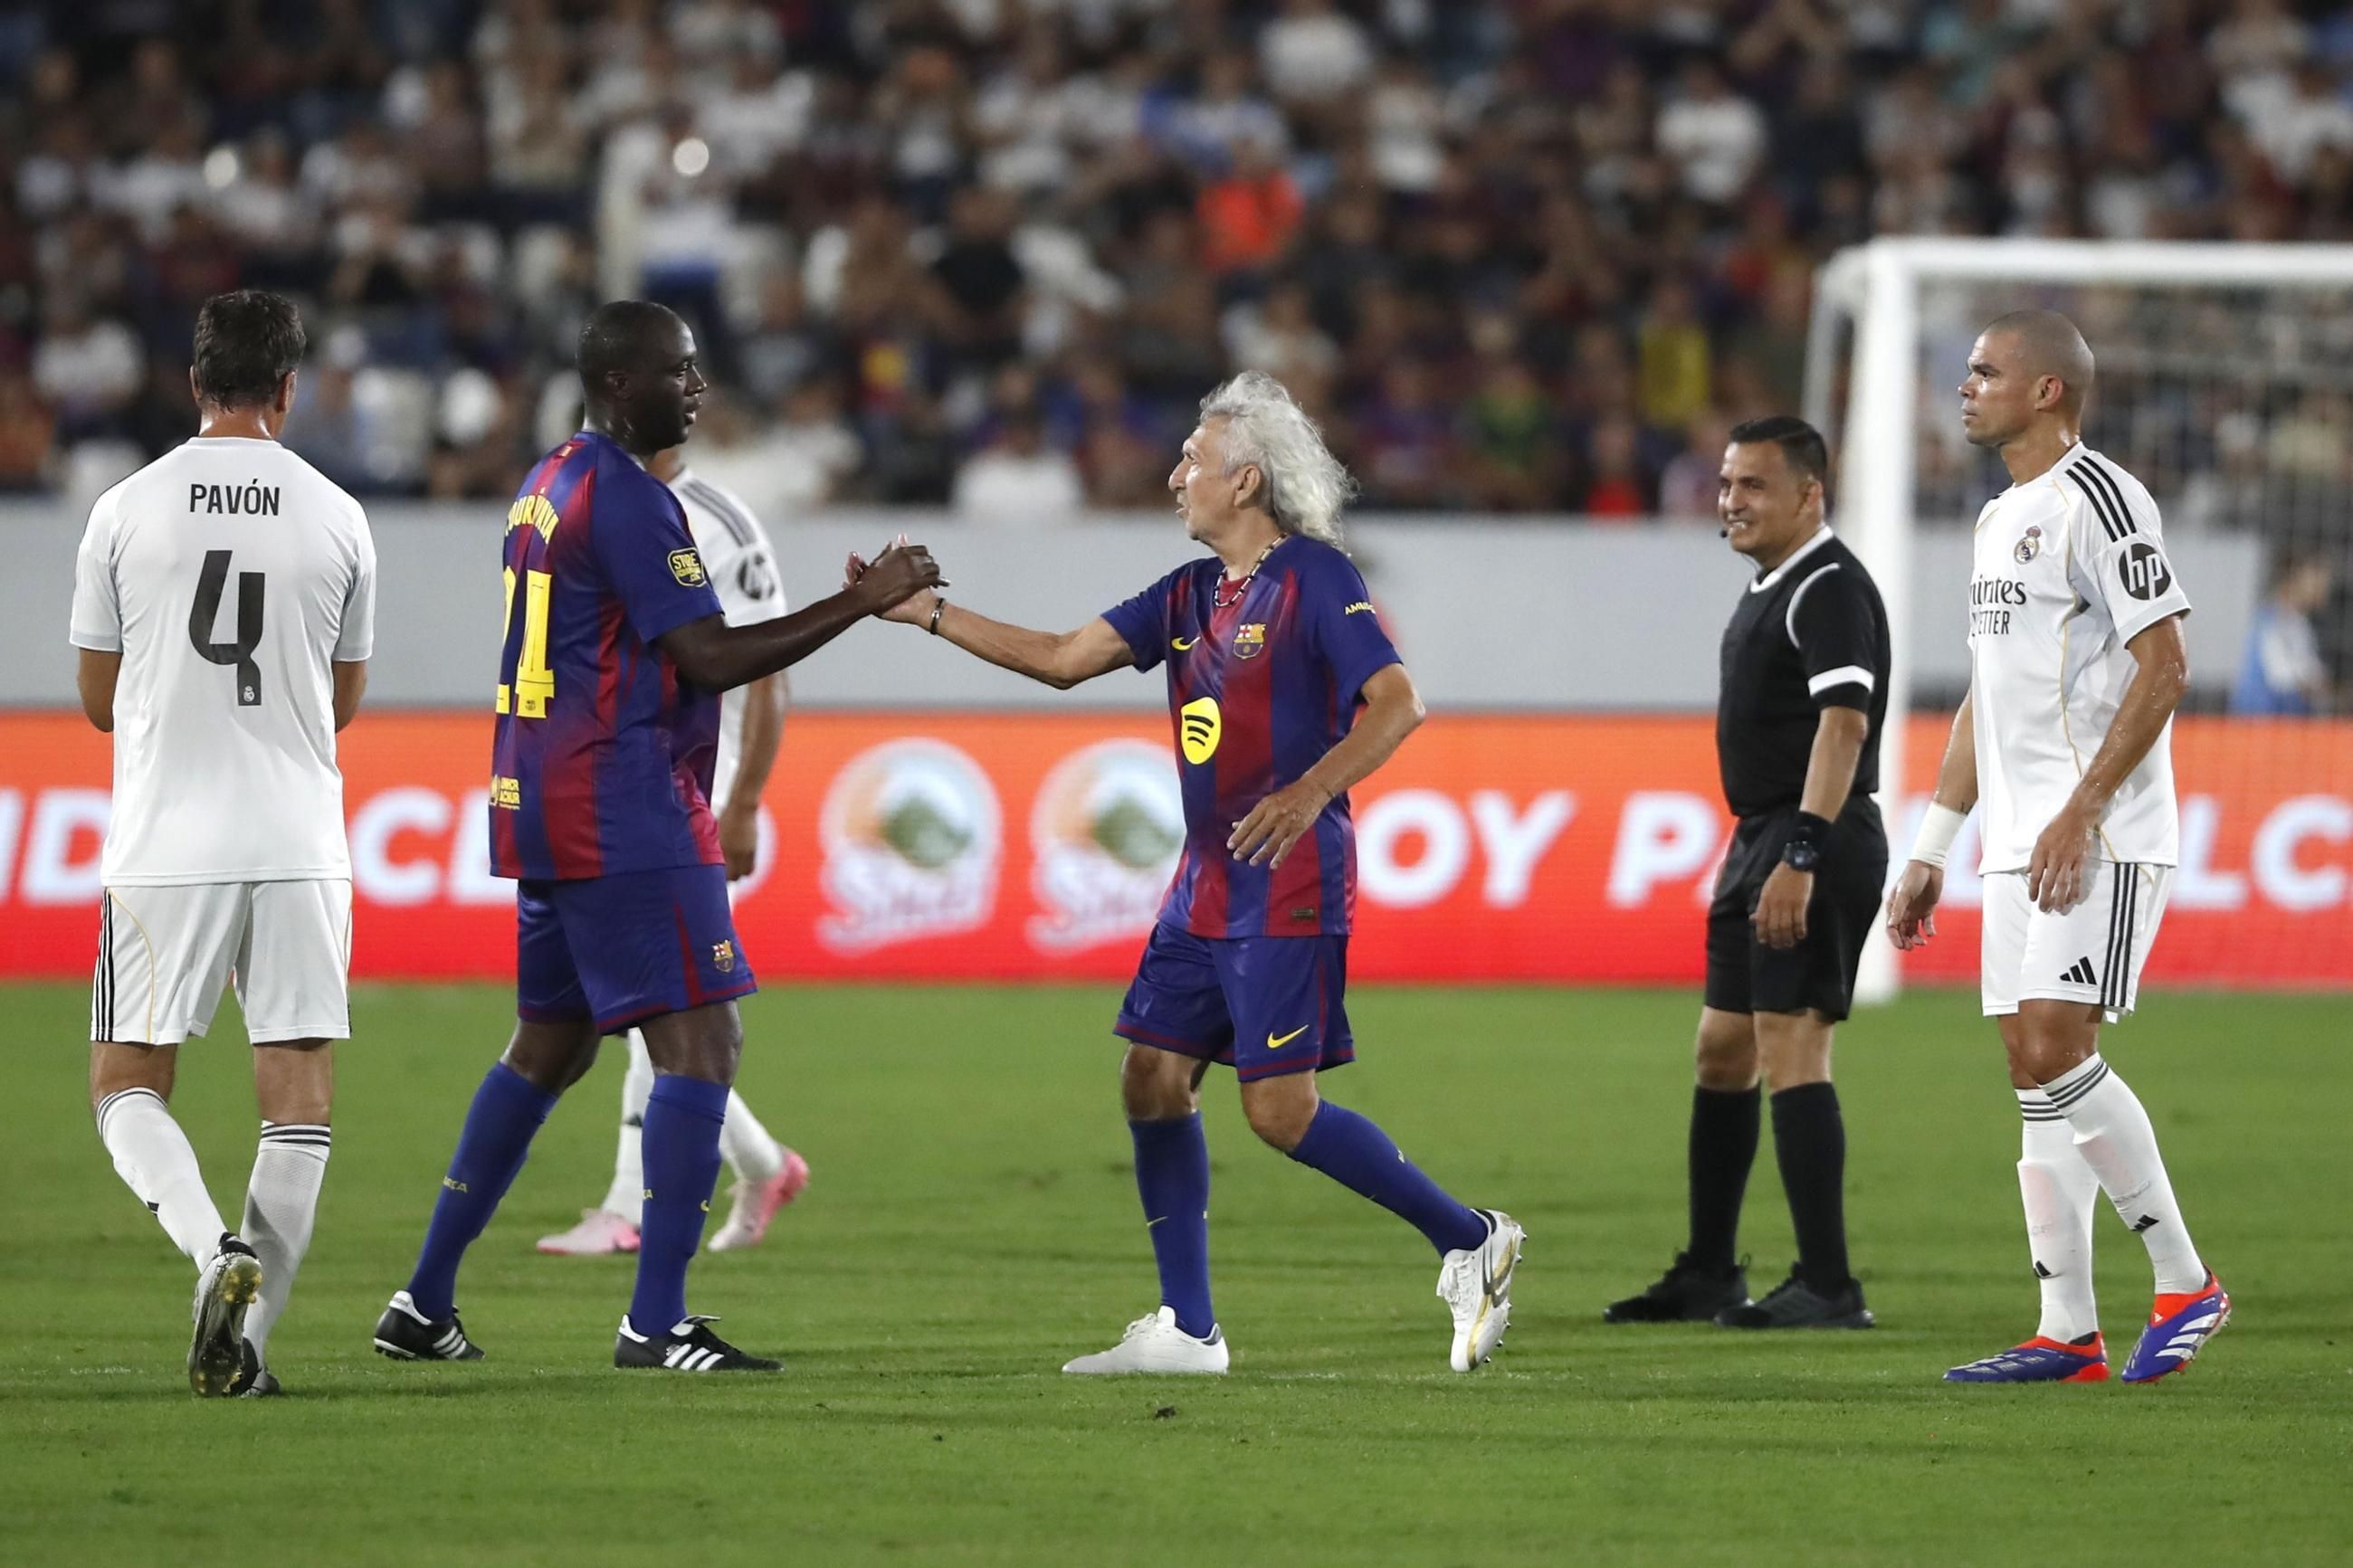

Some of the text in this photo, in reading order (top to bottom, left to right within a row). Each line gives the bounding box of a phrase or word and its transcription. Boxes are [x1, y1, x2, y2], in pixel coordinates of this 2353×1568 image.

[190, 478, 280, 516] PAVÓN
[2120, 543, 2170, 601] hp
[188, 550, 265, 706] 4
